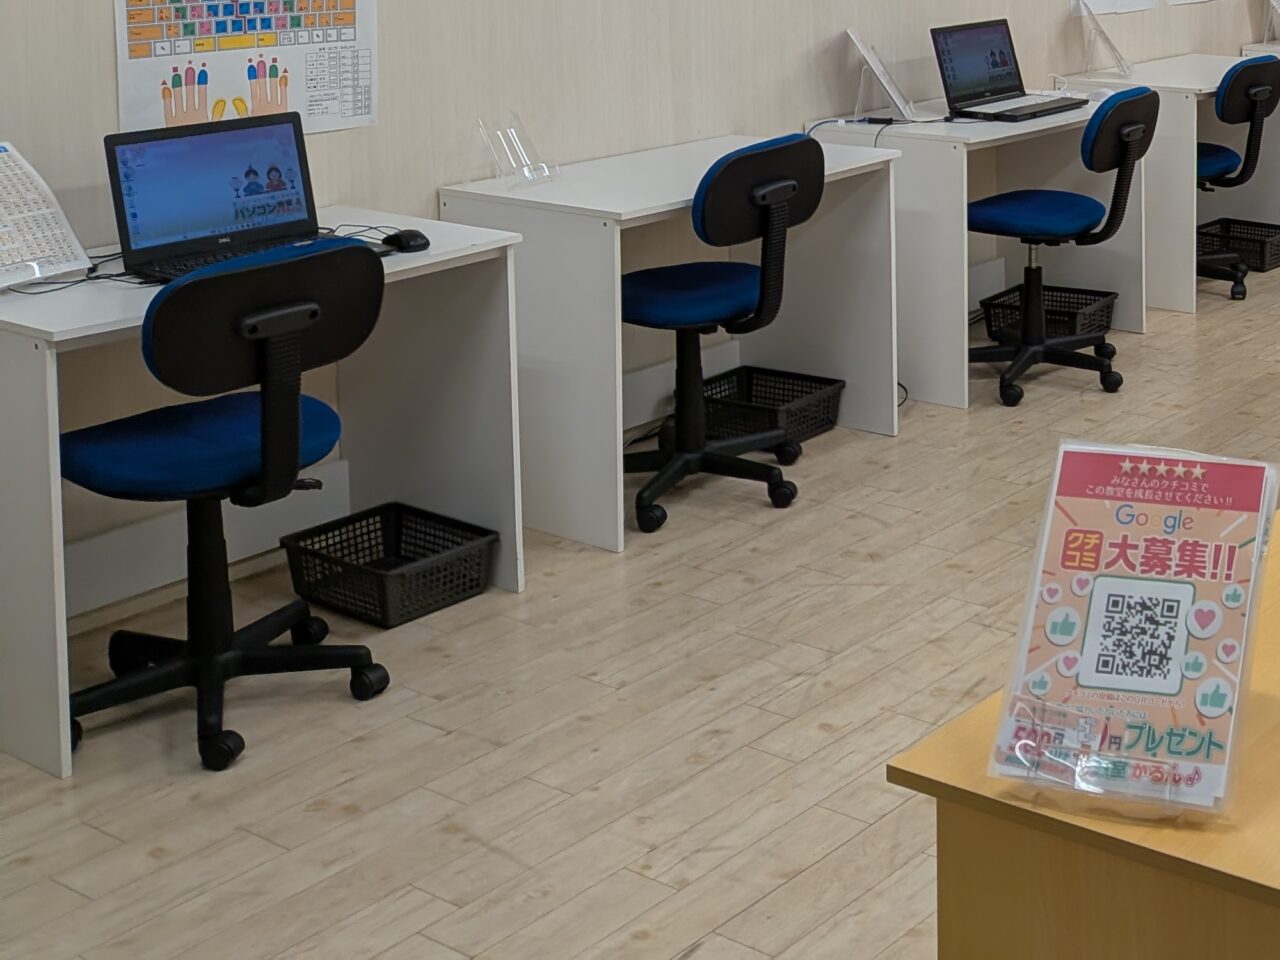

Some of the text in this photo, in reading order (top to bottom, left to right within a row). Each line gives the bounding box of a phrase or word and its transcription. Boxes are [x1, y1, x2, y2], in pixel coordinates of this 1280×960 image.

[1110, 475, 1209, 492] みなさんのクチコミで
[1104, 535, 1238, 581] 大募集!!
[1125, 723, 1224, 759] プレゼント
